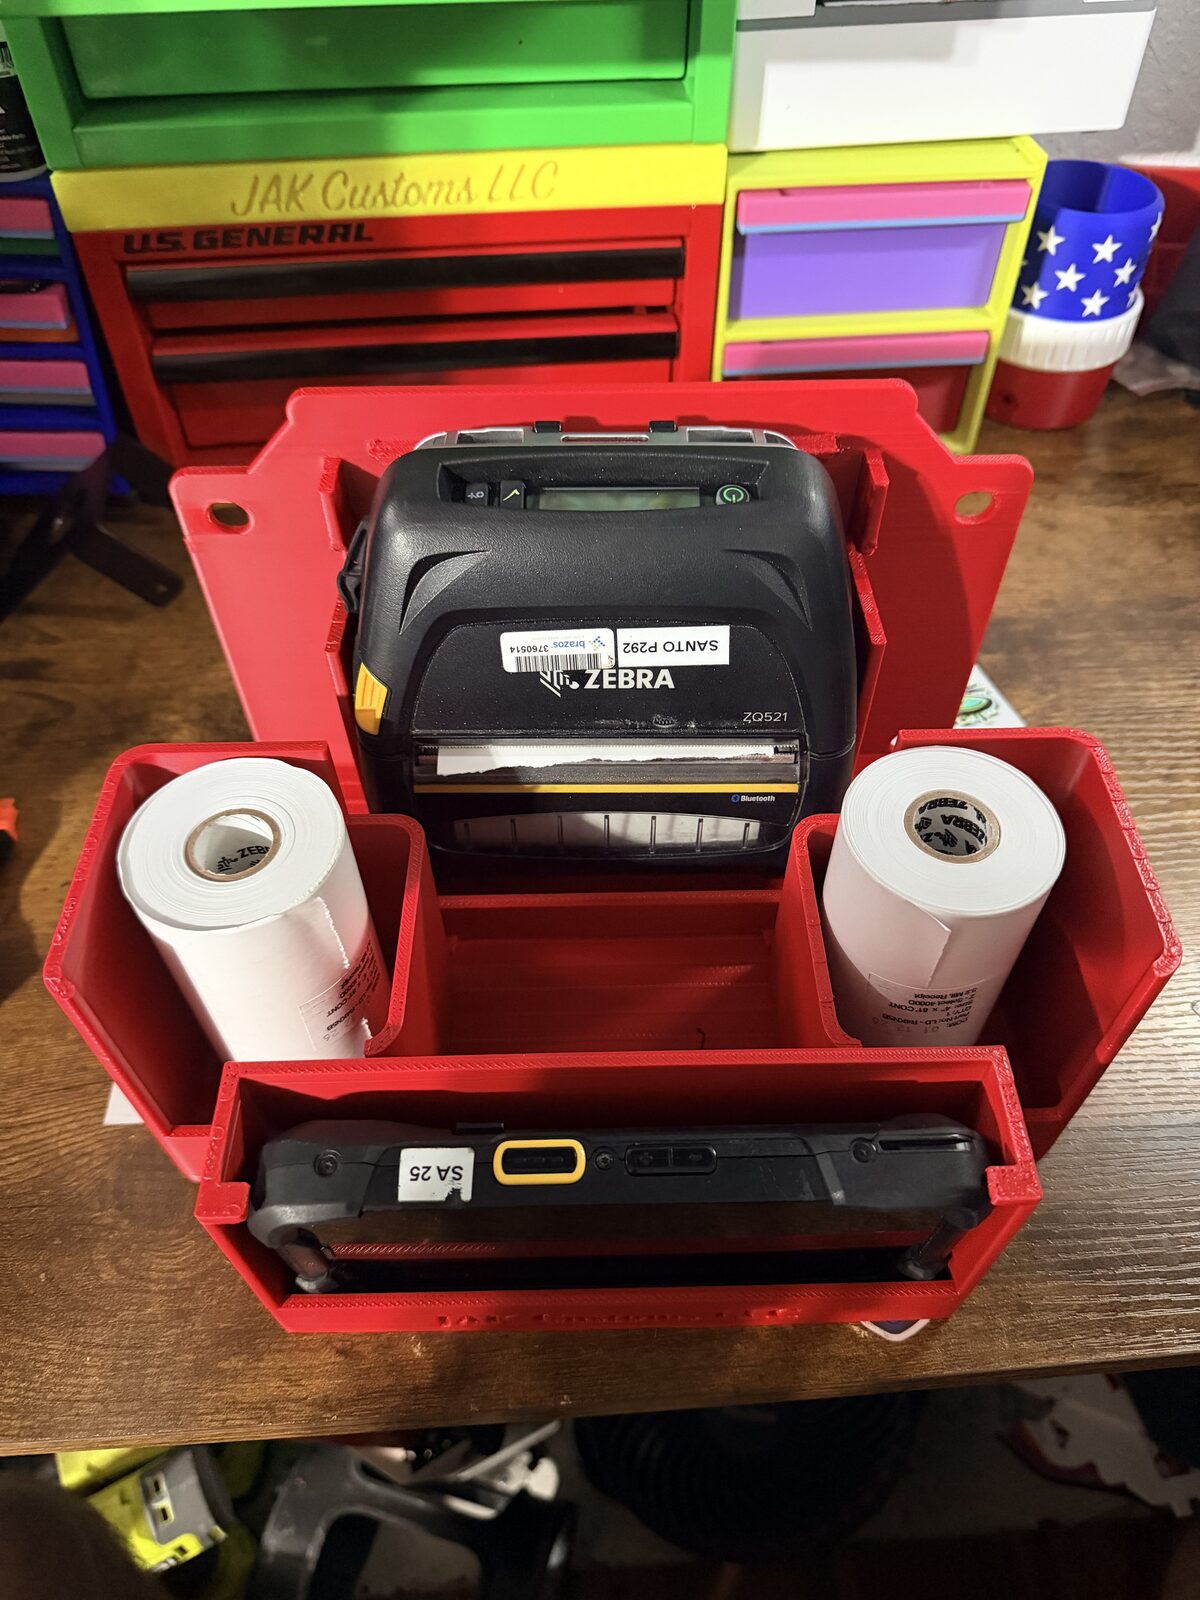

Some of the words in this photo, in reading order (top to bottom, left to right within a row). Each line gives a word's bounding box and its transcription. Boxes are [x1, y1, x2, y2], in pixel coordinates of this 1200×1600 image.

[230, 174, 314, 217] JAK
[321, 169, 477, 212] Customs
[486, 162, 559, 202] LLC
[123, 231, 185, 255] U.S.
[194, 223, 374, 249] GENERAL
[509, 644, 549, 654] 3760514
[552, 639, 586, 650] brazos
[622, 641, 658, 654] P292
[662, 639, 719, 652] SANTO
[583, 668, 676, 689] ZEBRA
[742, 711, 789, 723] ZQ521
[409, 1165, 432, 1182] 25
[438, 1165, 465, 1182] SA
